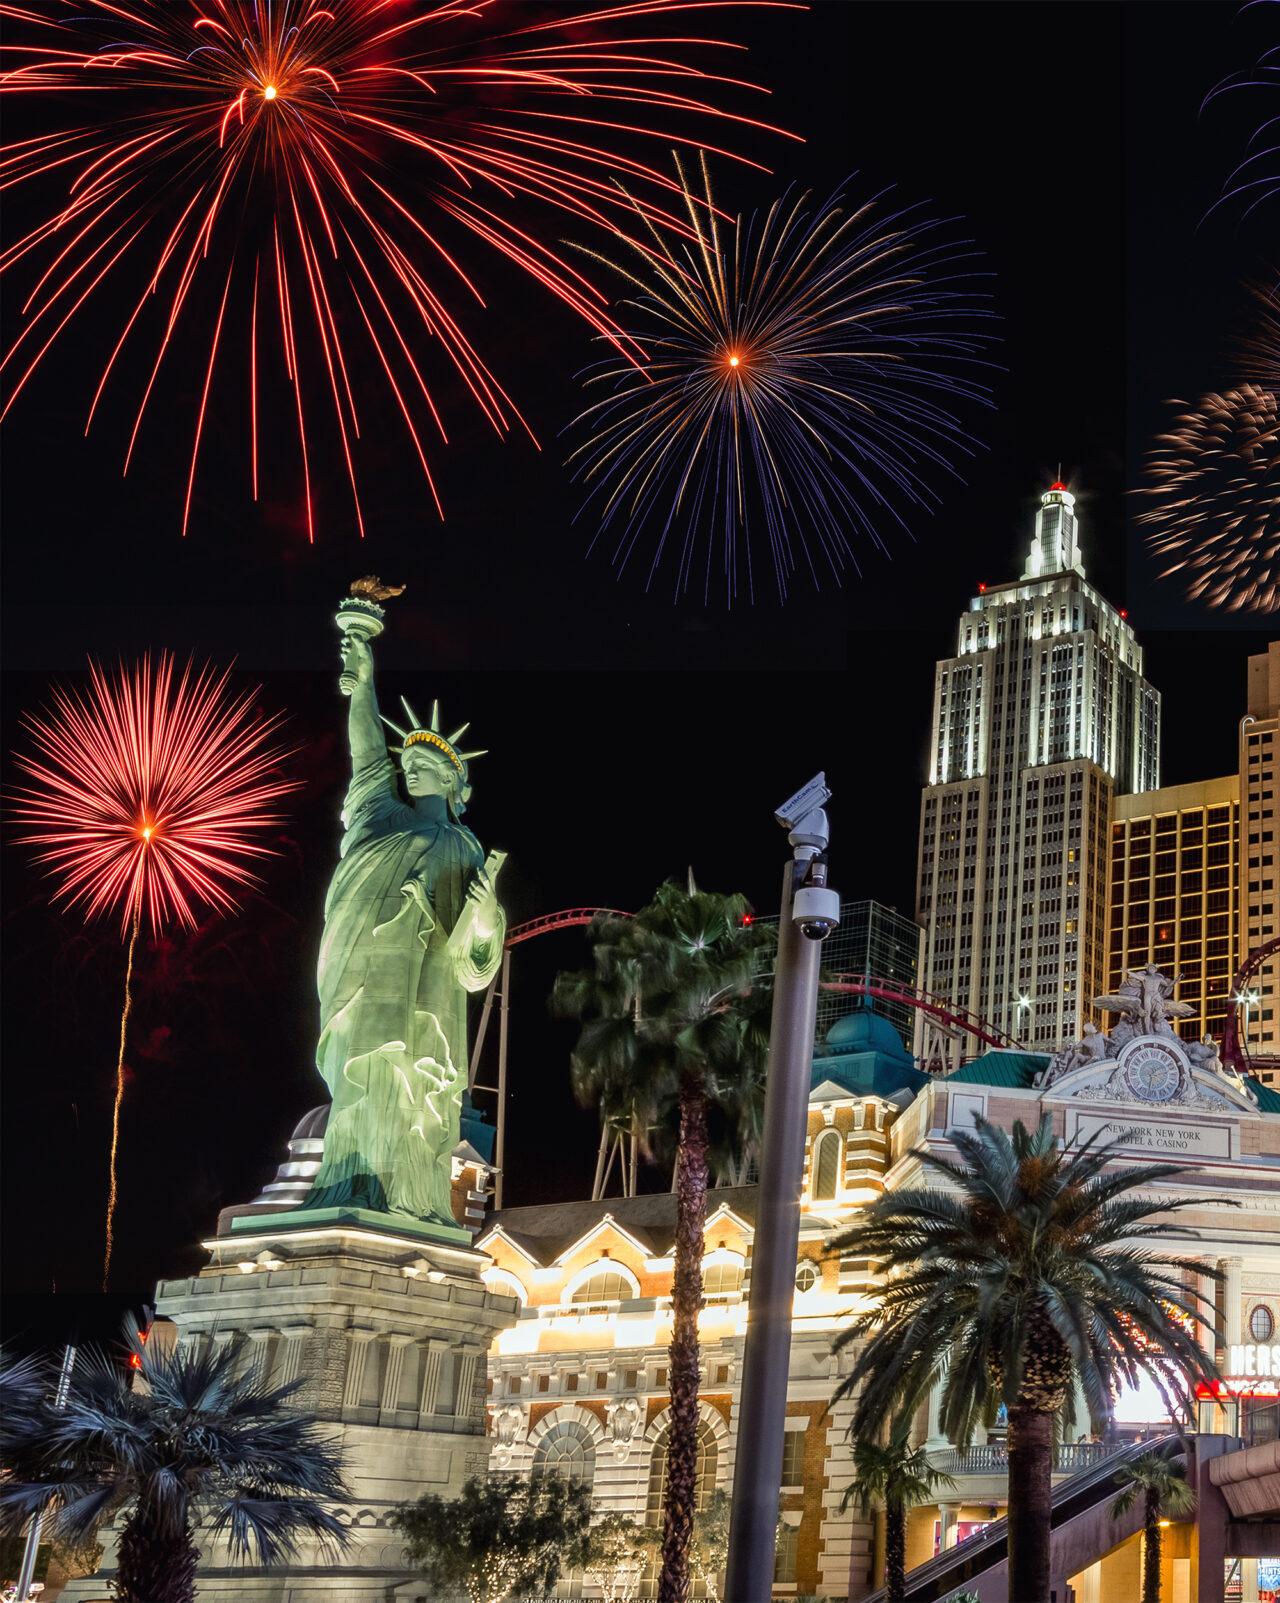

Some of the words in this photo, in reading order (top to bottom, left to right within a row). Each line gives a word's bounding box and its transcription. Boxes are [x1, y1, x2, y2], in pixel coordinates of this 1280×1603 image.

[1106, 1124, 1127, 1133] NEW
[1129, 1126, 1152, 1136] YORK
[1155, 1128, 1174, 1138] NEW
[1178, 1130, 1201, 1141] YORK
[1117, 1135, 1145, 1145] HOTEL
[1156, 1140, 1188, 1149] CASINO
